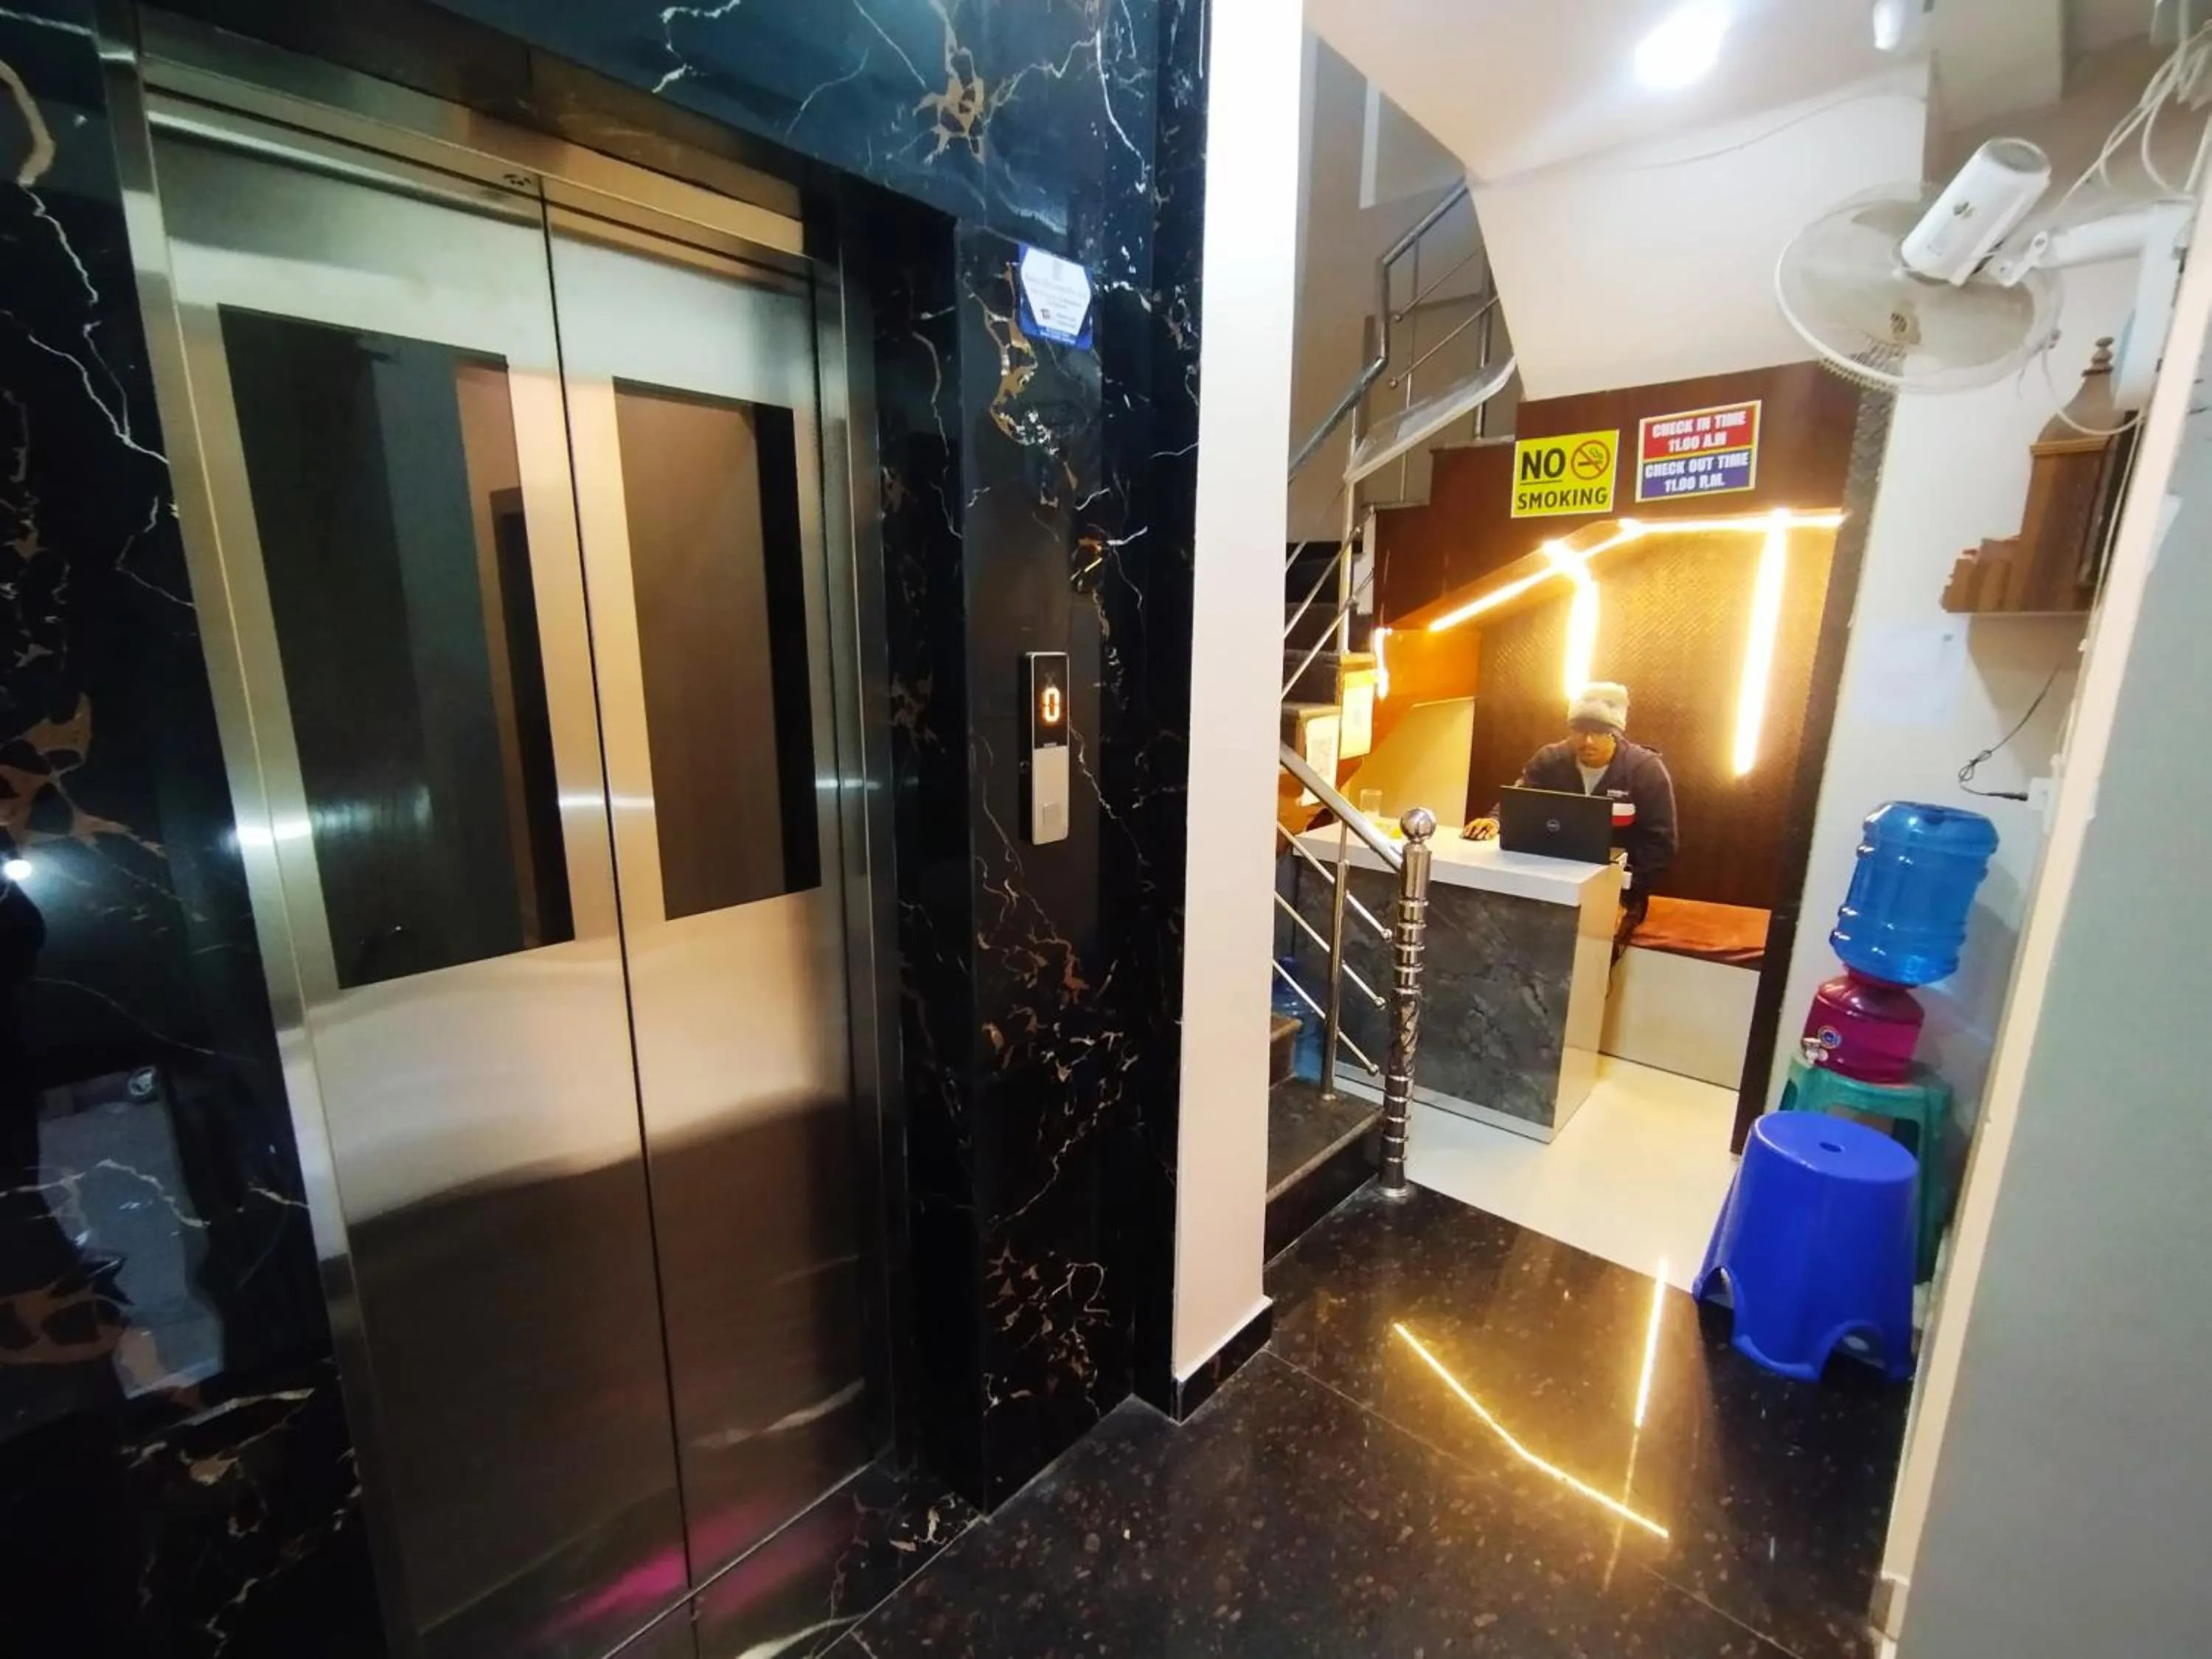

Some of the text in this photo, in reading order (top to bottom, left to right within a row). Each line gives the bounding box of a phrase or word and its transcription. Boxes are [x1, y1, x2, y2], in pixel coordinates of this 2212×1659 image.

[1652, 411, 1747, 439] CHECK IN TIME
[1668, 435, 1700, 453] 11.00
[1521, 448, 1566, 481] NO
[1645, 452, 1749, 479] CHECK OUT TIME
[1665, 476, 1696, 493] 11.00
[1517, 487, 1607, 510] SMOKING
